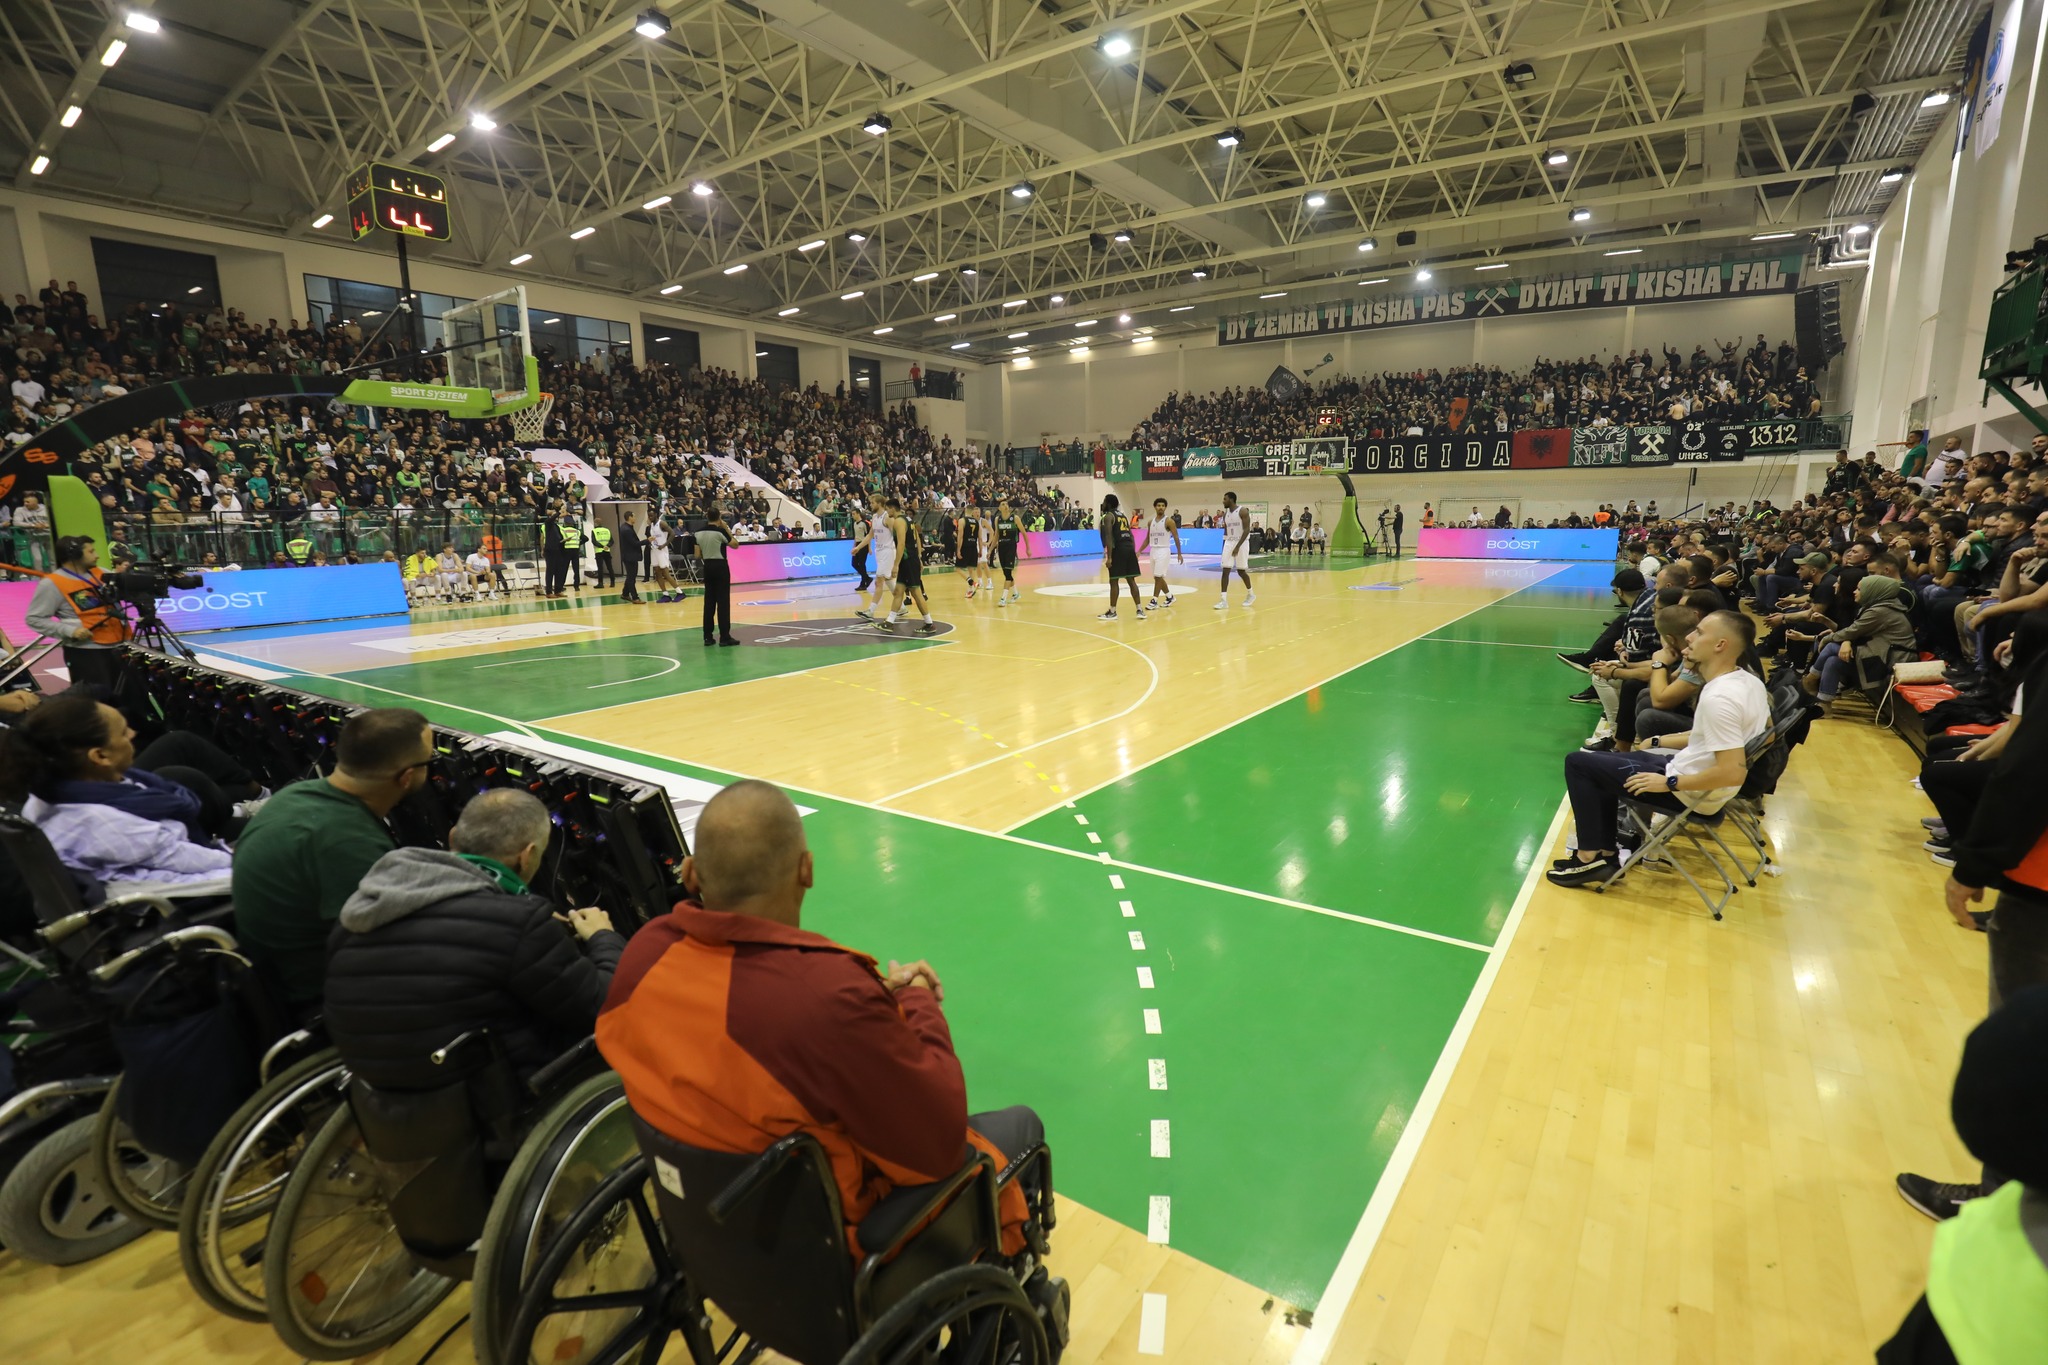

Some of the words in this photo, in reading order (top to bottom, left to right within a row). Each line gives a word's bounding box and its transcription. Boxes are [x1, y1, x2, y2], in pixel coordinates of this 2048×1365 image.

[1226, 317, 1250, 341] DY
[1254, 311, 1319, 339] ZEMRA
[1327, 305, 1346, 330] TI
[1351, 299, 1416, 327] KISHA
[1421, 291, 1467, 319] PAS
[1518, 277, 1594, 309] DYJAT
[1600, 273, 1631, 302] TI
[1635, 265, 1722, 299] KISHA
[1729, 260, 1788, 292] FAL
[390, 386, 426, 397] SPORT
[426, 389, 468, 400] SYSTEM
[1265, 443, 1306, 455] GREEN
[1678, 452, 1709, 460] Ultras
[1184, 452, 1220, 470] Garda
[1225, 458, 1259, 472] BAIR
[1266, 461, 1305, 475] ELIE
[970, 524, 976, 536] 7
[1050, 540, 1073, 549] BOOST
[1486, 540, 1541, 550] BOOST
[782, 554, 827, 568] BOOST
[154, 591, 268, 614] BOOST
